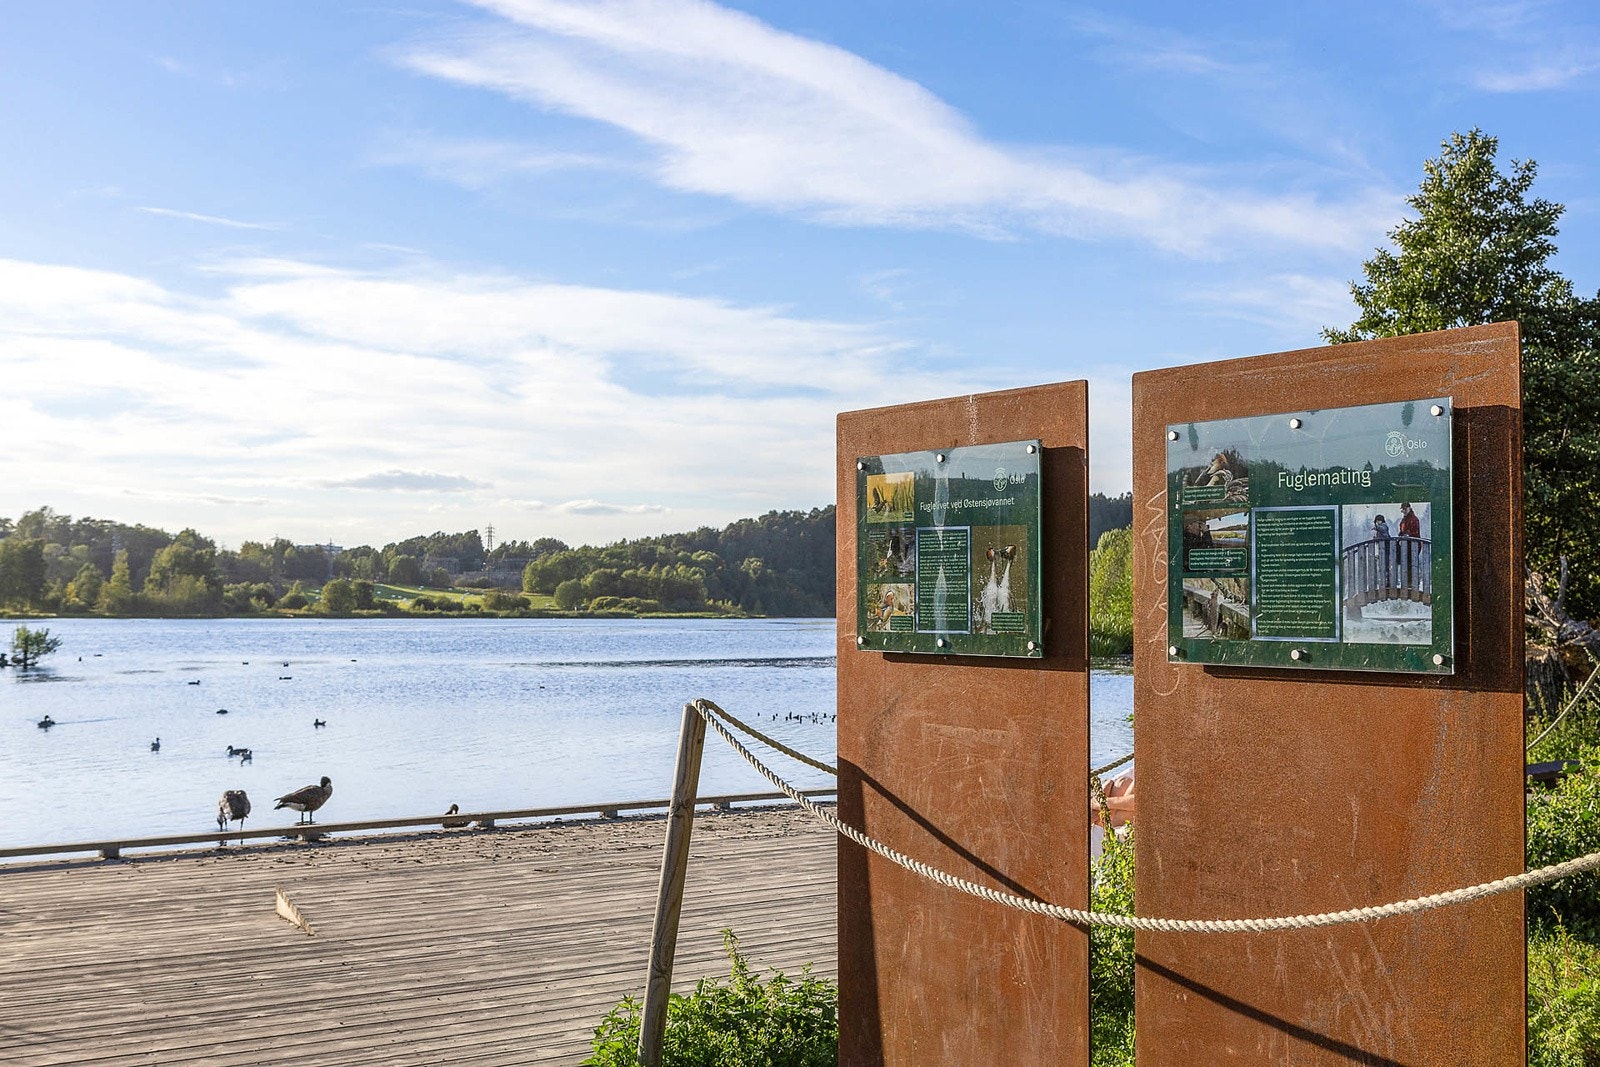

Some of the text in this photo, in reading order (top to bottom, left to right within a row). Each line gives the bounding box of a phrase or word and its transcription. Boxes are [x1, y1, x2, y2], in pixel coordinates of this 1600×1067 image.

[1407, 439, 1428, 450] Oslo
[1009, 475, 1025, 485] Oslo
[1278, 468, 1371, 491] Fuglemating
[951, 499, 963, 509] ved
